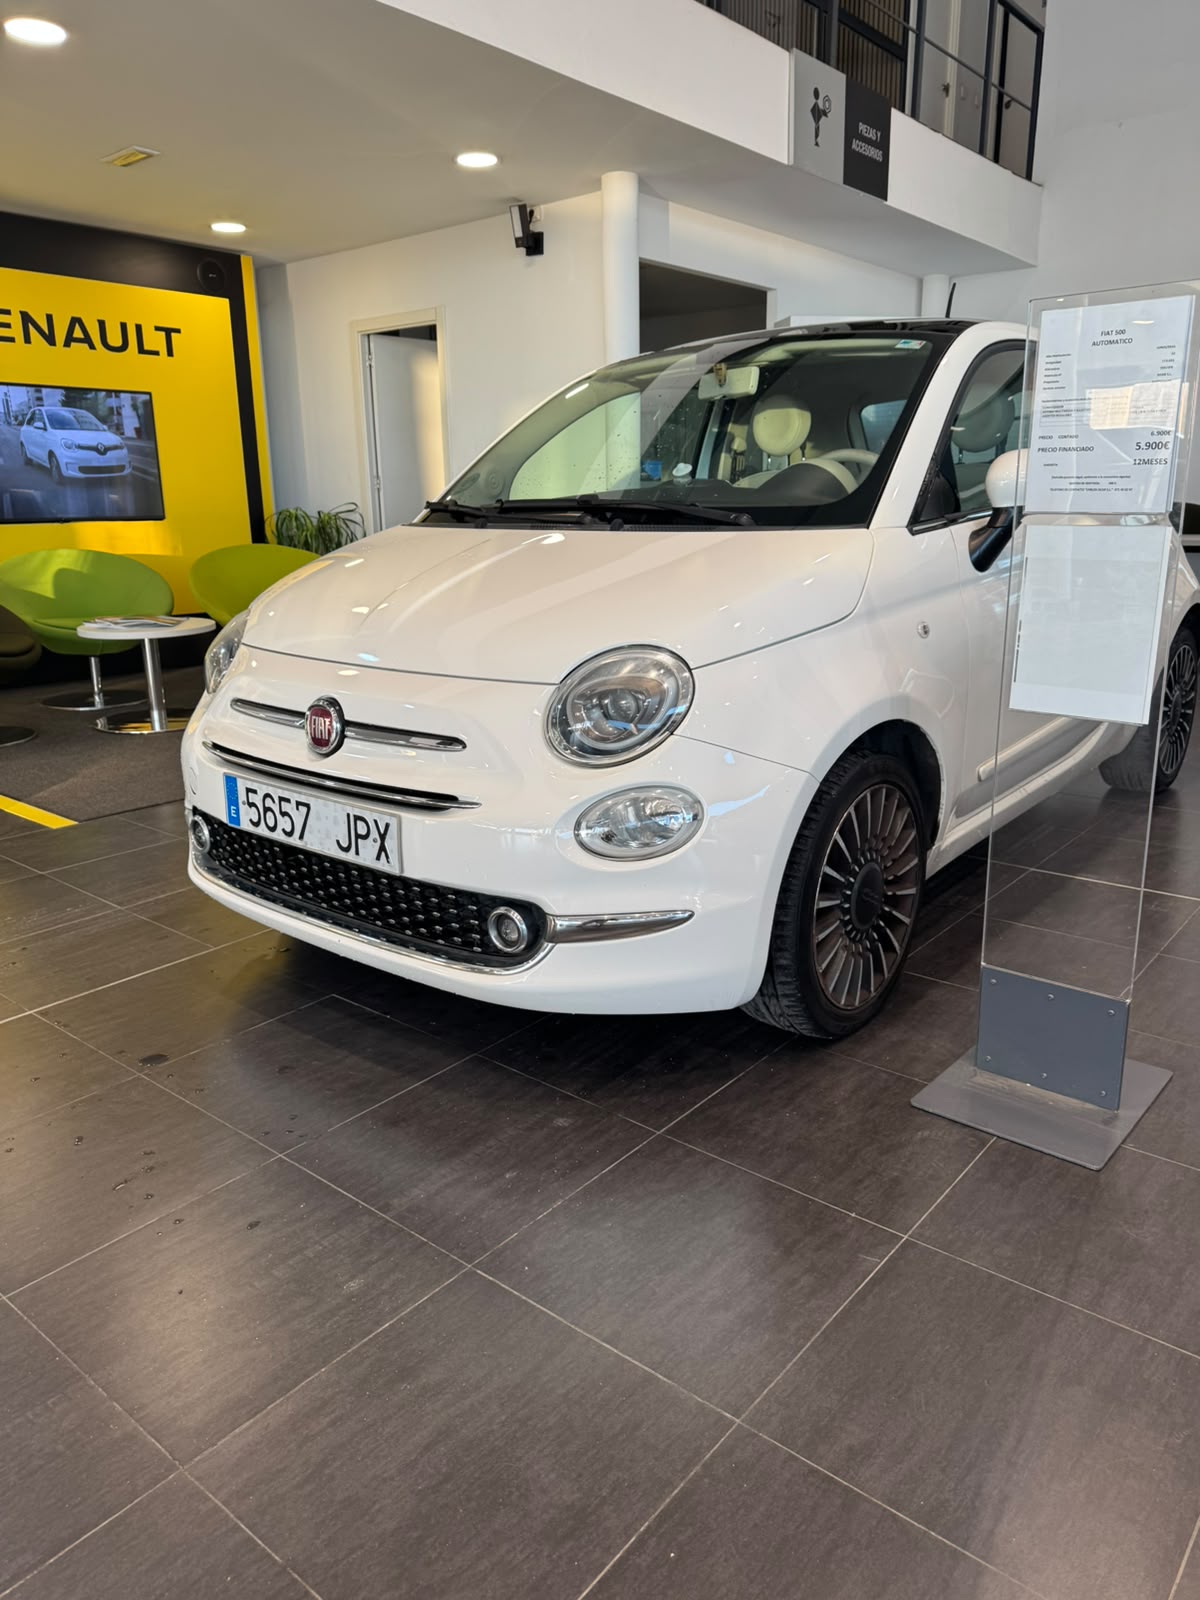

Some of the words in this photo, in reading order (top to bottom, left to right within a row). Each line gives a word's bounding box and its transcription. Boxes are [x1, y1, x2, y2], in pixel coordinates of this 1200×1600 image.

[858, 121, 877, 141] PIEZAS
[876, 131, 881, 142] Y
[851, 138, 883, 162] ACCESORIOS
[1100, 329, 1114, 337] FIAT
[1115, 328, 1126, 336] 500
[1091, 337, 1133, 347] AUTOMATICO
[1058, 445, 1094, 453] FINANCIADO
[1135, 440, 1170, 451] 5.900€
[1132, 457, 1168, 466] 12MESES
[311, 715, 332, 740] FIAT
[230, 805, 237, 818] E
[245, 786, 311, 841] 5657
[335, 812, 391, 864] JPX
